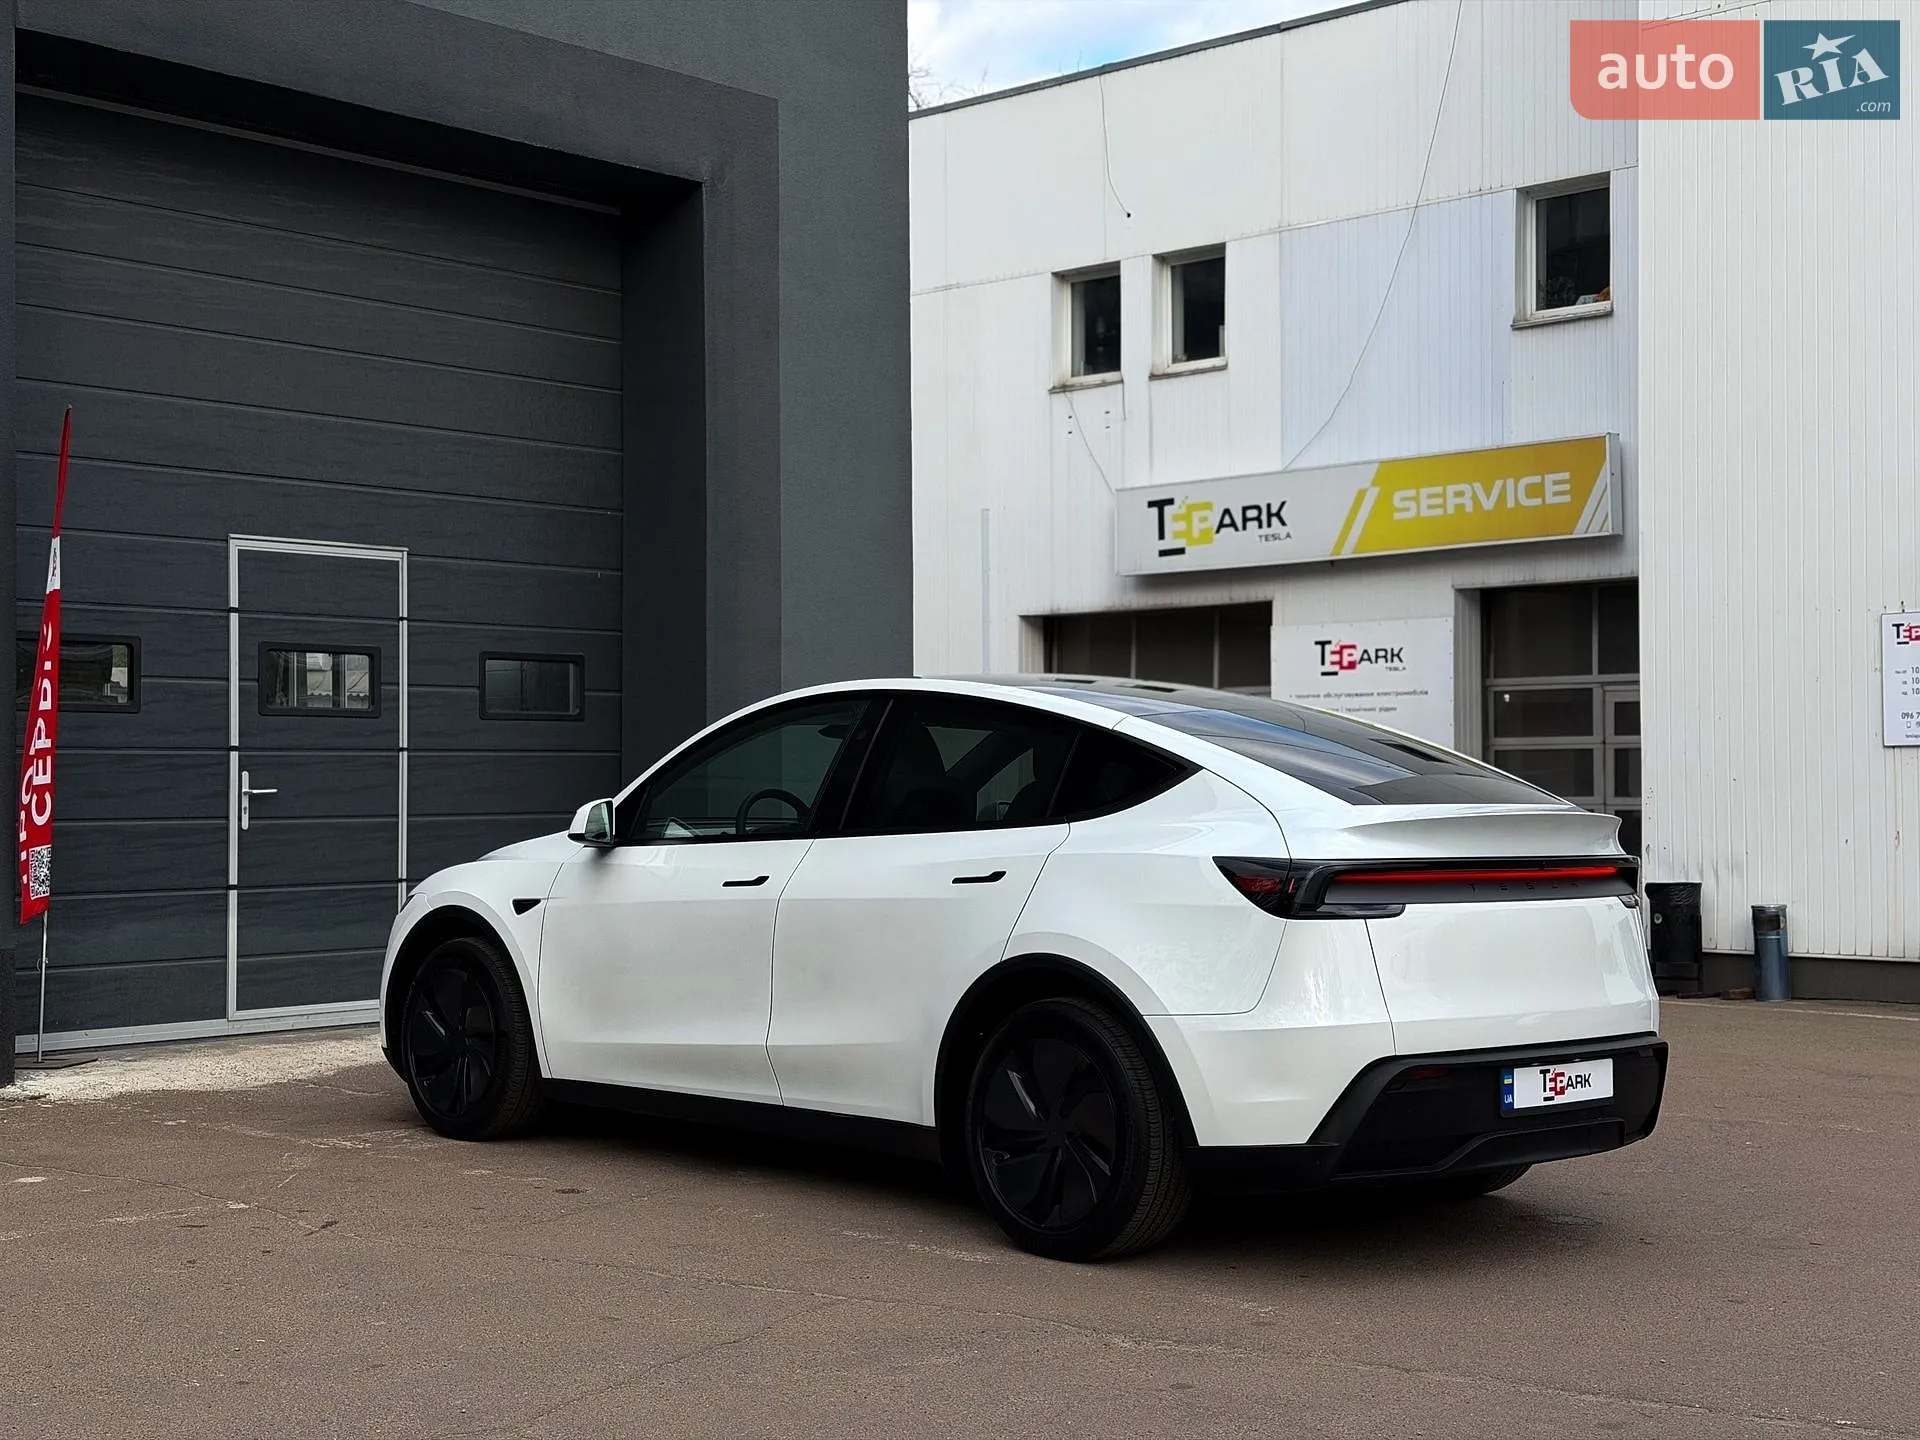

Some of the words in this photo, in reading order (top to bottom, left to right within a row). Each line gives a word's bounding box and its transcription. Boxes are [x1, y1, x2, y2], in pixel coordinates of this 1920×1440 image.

[1392, 471, 1571, 521] SERVICE
[1258, 532, 1292, 543] TESLA
[1504, 1094, 1513, 1104] UA
